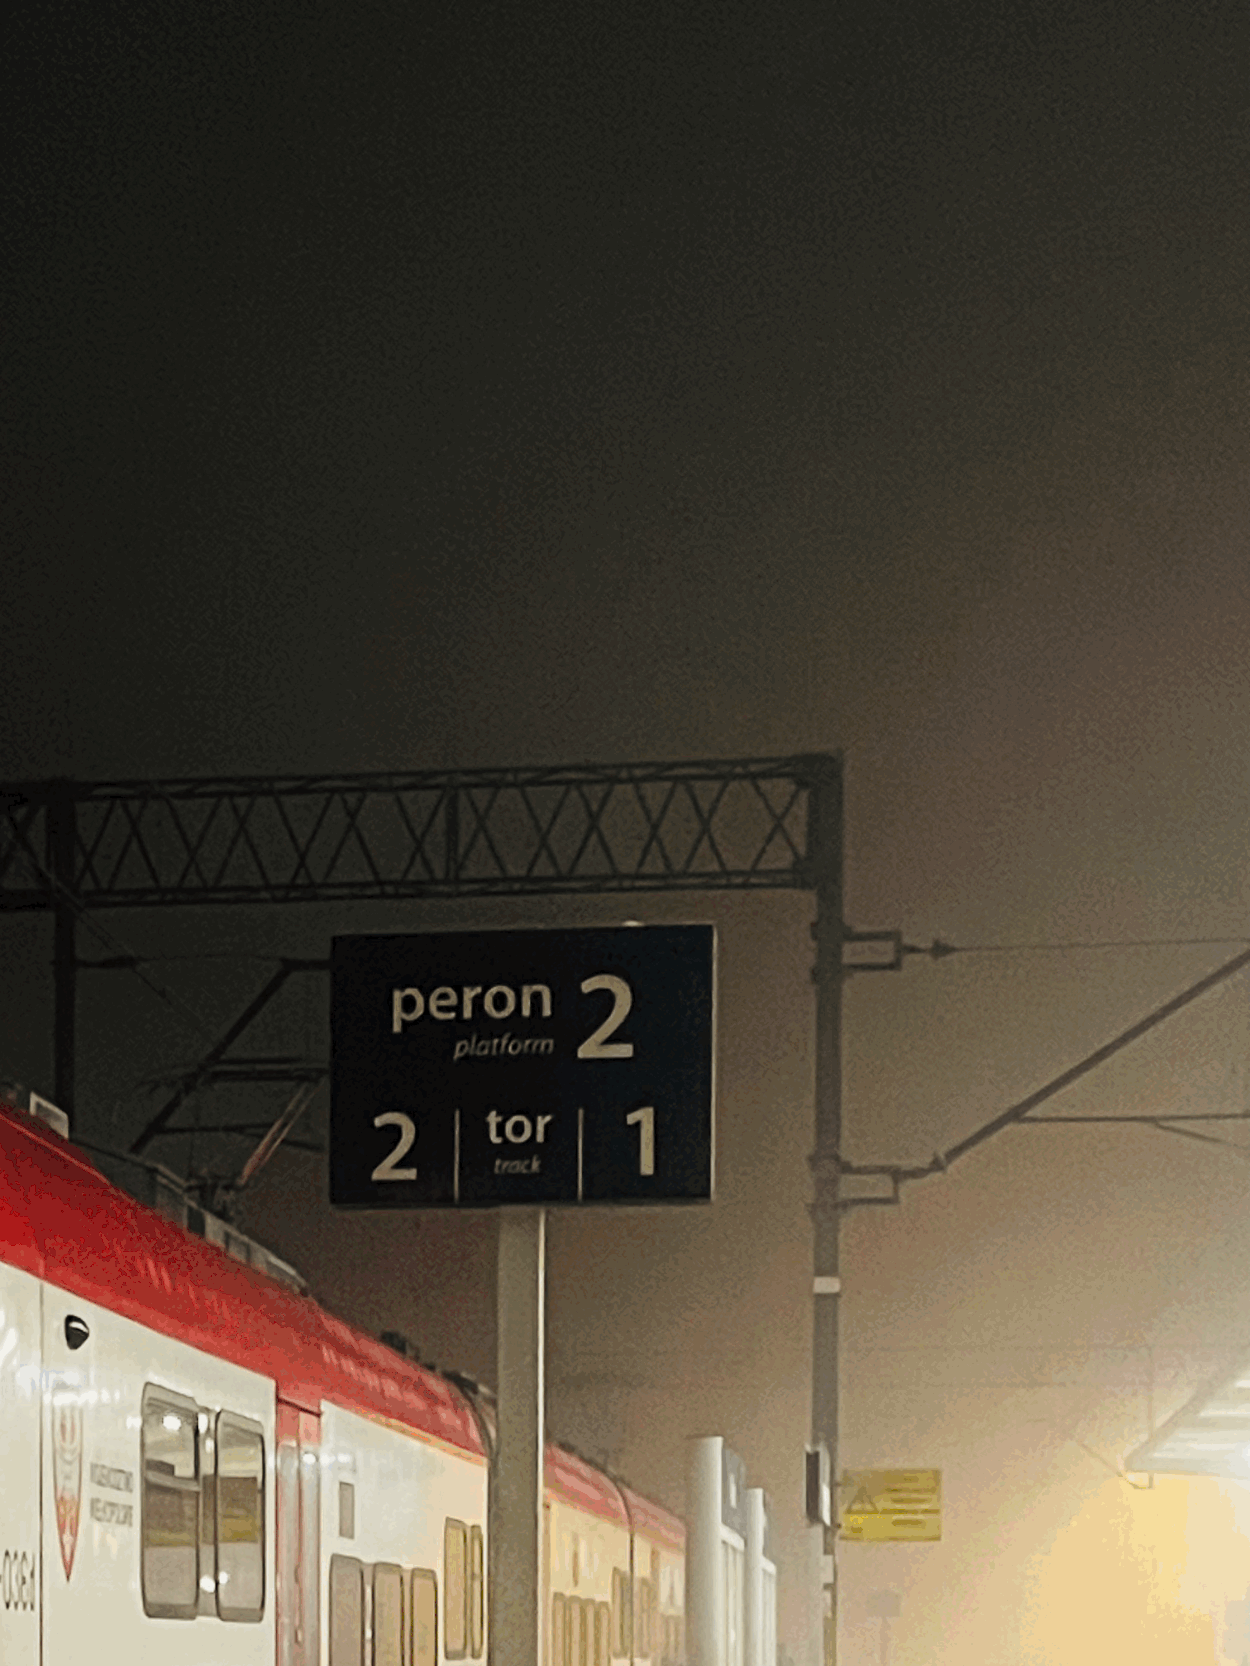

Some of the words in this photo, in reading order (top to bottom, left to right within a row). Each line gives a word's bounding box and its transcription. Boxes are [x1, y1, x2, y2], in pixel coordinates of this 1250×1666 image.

[392, 983, 552, 1033] peron
[577, 973, 634, 1059] 2
[453, 1032, 554, 1061] platform
[371, 1111, 418, 1181] 2
[486, 1110, 552, 1144] tor
[626, 1106, 655, 1176] 1
[493, 1154, 541, 1175] track
